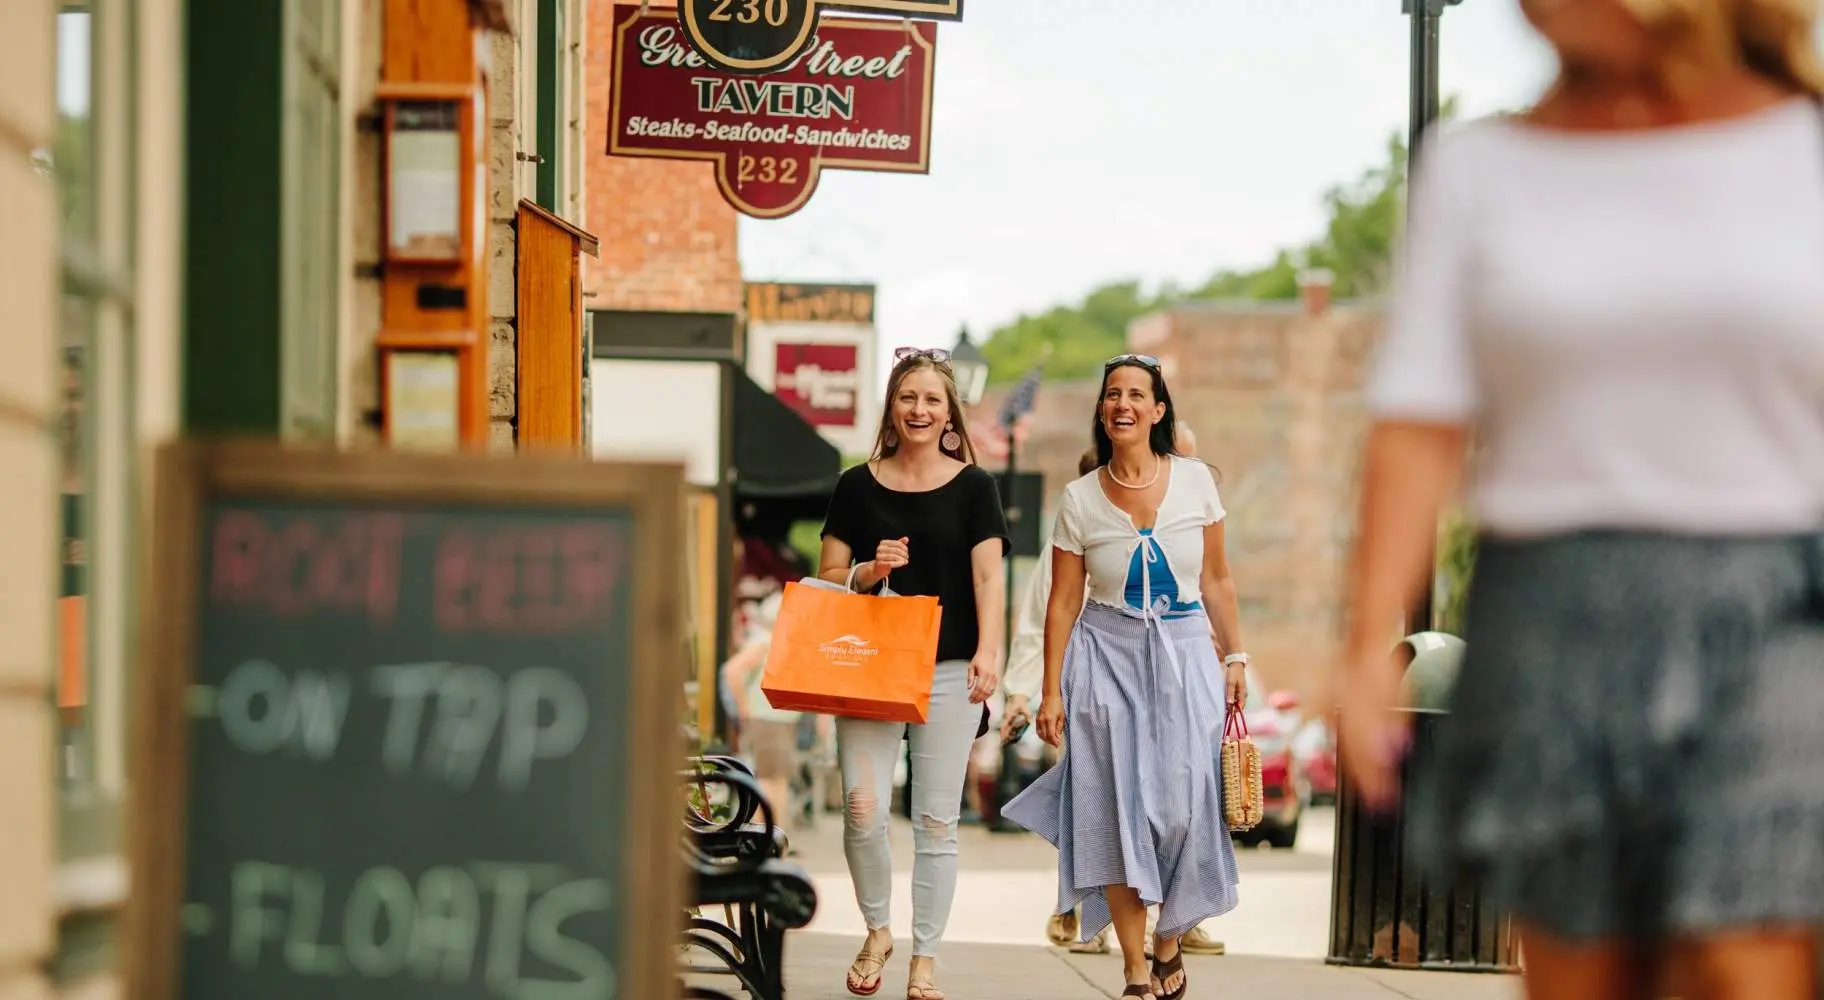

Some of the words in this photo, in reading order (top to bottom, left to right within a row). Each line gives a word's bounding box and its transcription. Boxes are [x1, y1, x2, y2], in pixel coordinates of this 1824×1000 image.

[708, 0, 789, 27] 230
[639, 24, 718, 70] Gre
[691, 77, 854, 121] TAVERN
[626, 116, 911, 150] Steaks-Seafood-Sandwiches
[738, 155, 798, 184] 232
[220, 660, 350, 760] ON
[369, 660, 590, 795] TAP
[231, 861, 617, 1000] FLOATS
